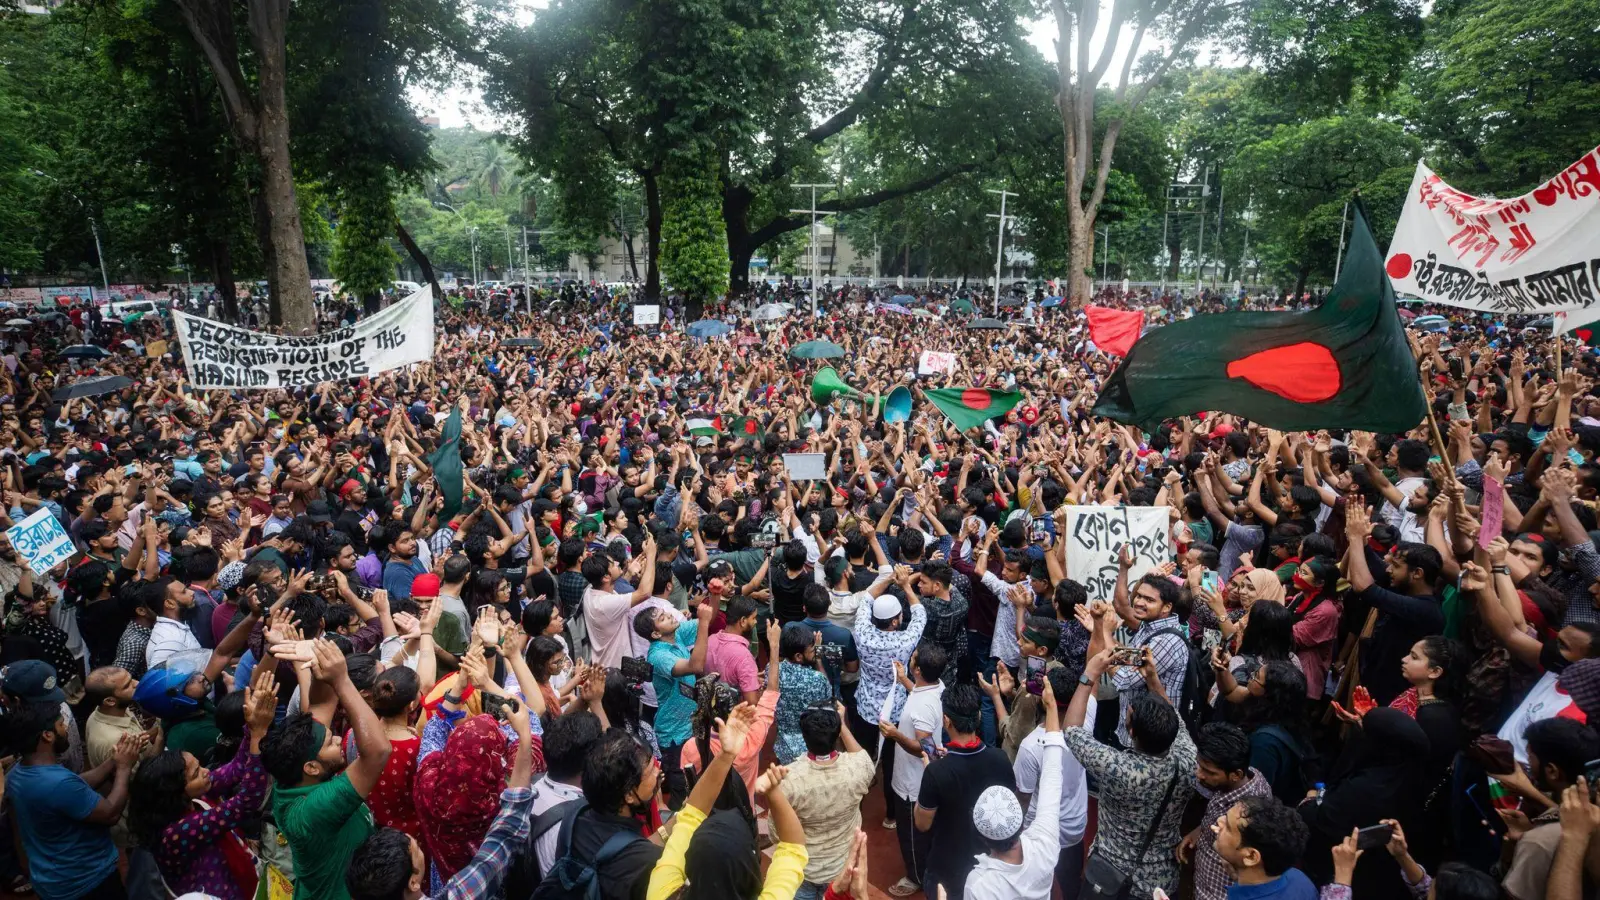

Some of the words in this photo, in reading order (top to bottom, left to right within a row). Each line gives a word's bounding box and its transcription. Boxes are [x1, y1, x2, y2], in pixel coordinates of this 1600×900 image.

[1414, 250, 1437, 294] এই
[1524, 261, 1596, 309] আমার
[185, 317, 268, 347] PEOPLE
[188, 341, 329, 366] RESIGNATION
[340, 336, 366, 358] OF
[372, 326, 406, 350] THE
[193, 363, 270, 387] HASINA
[278, 356, 369, 387] REGIME
[1073, 507, 1130, 551] কোন
[53, 540, 73, 556] যাক
